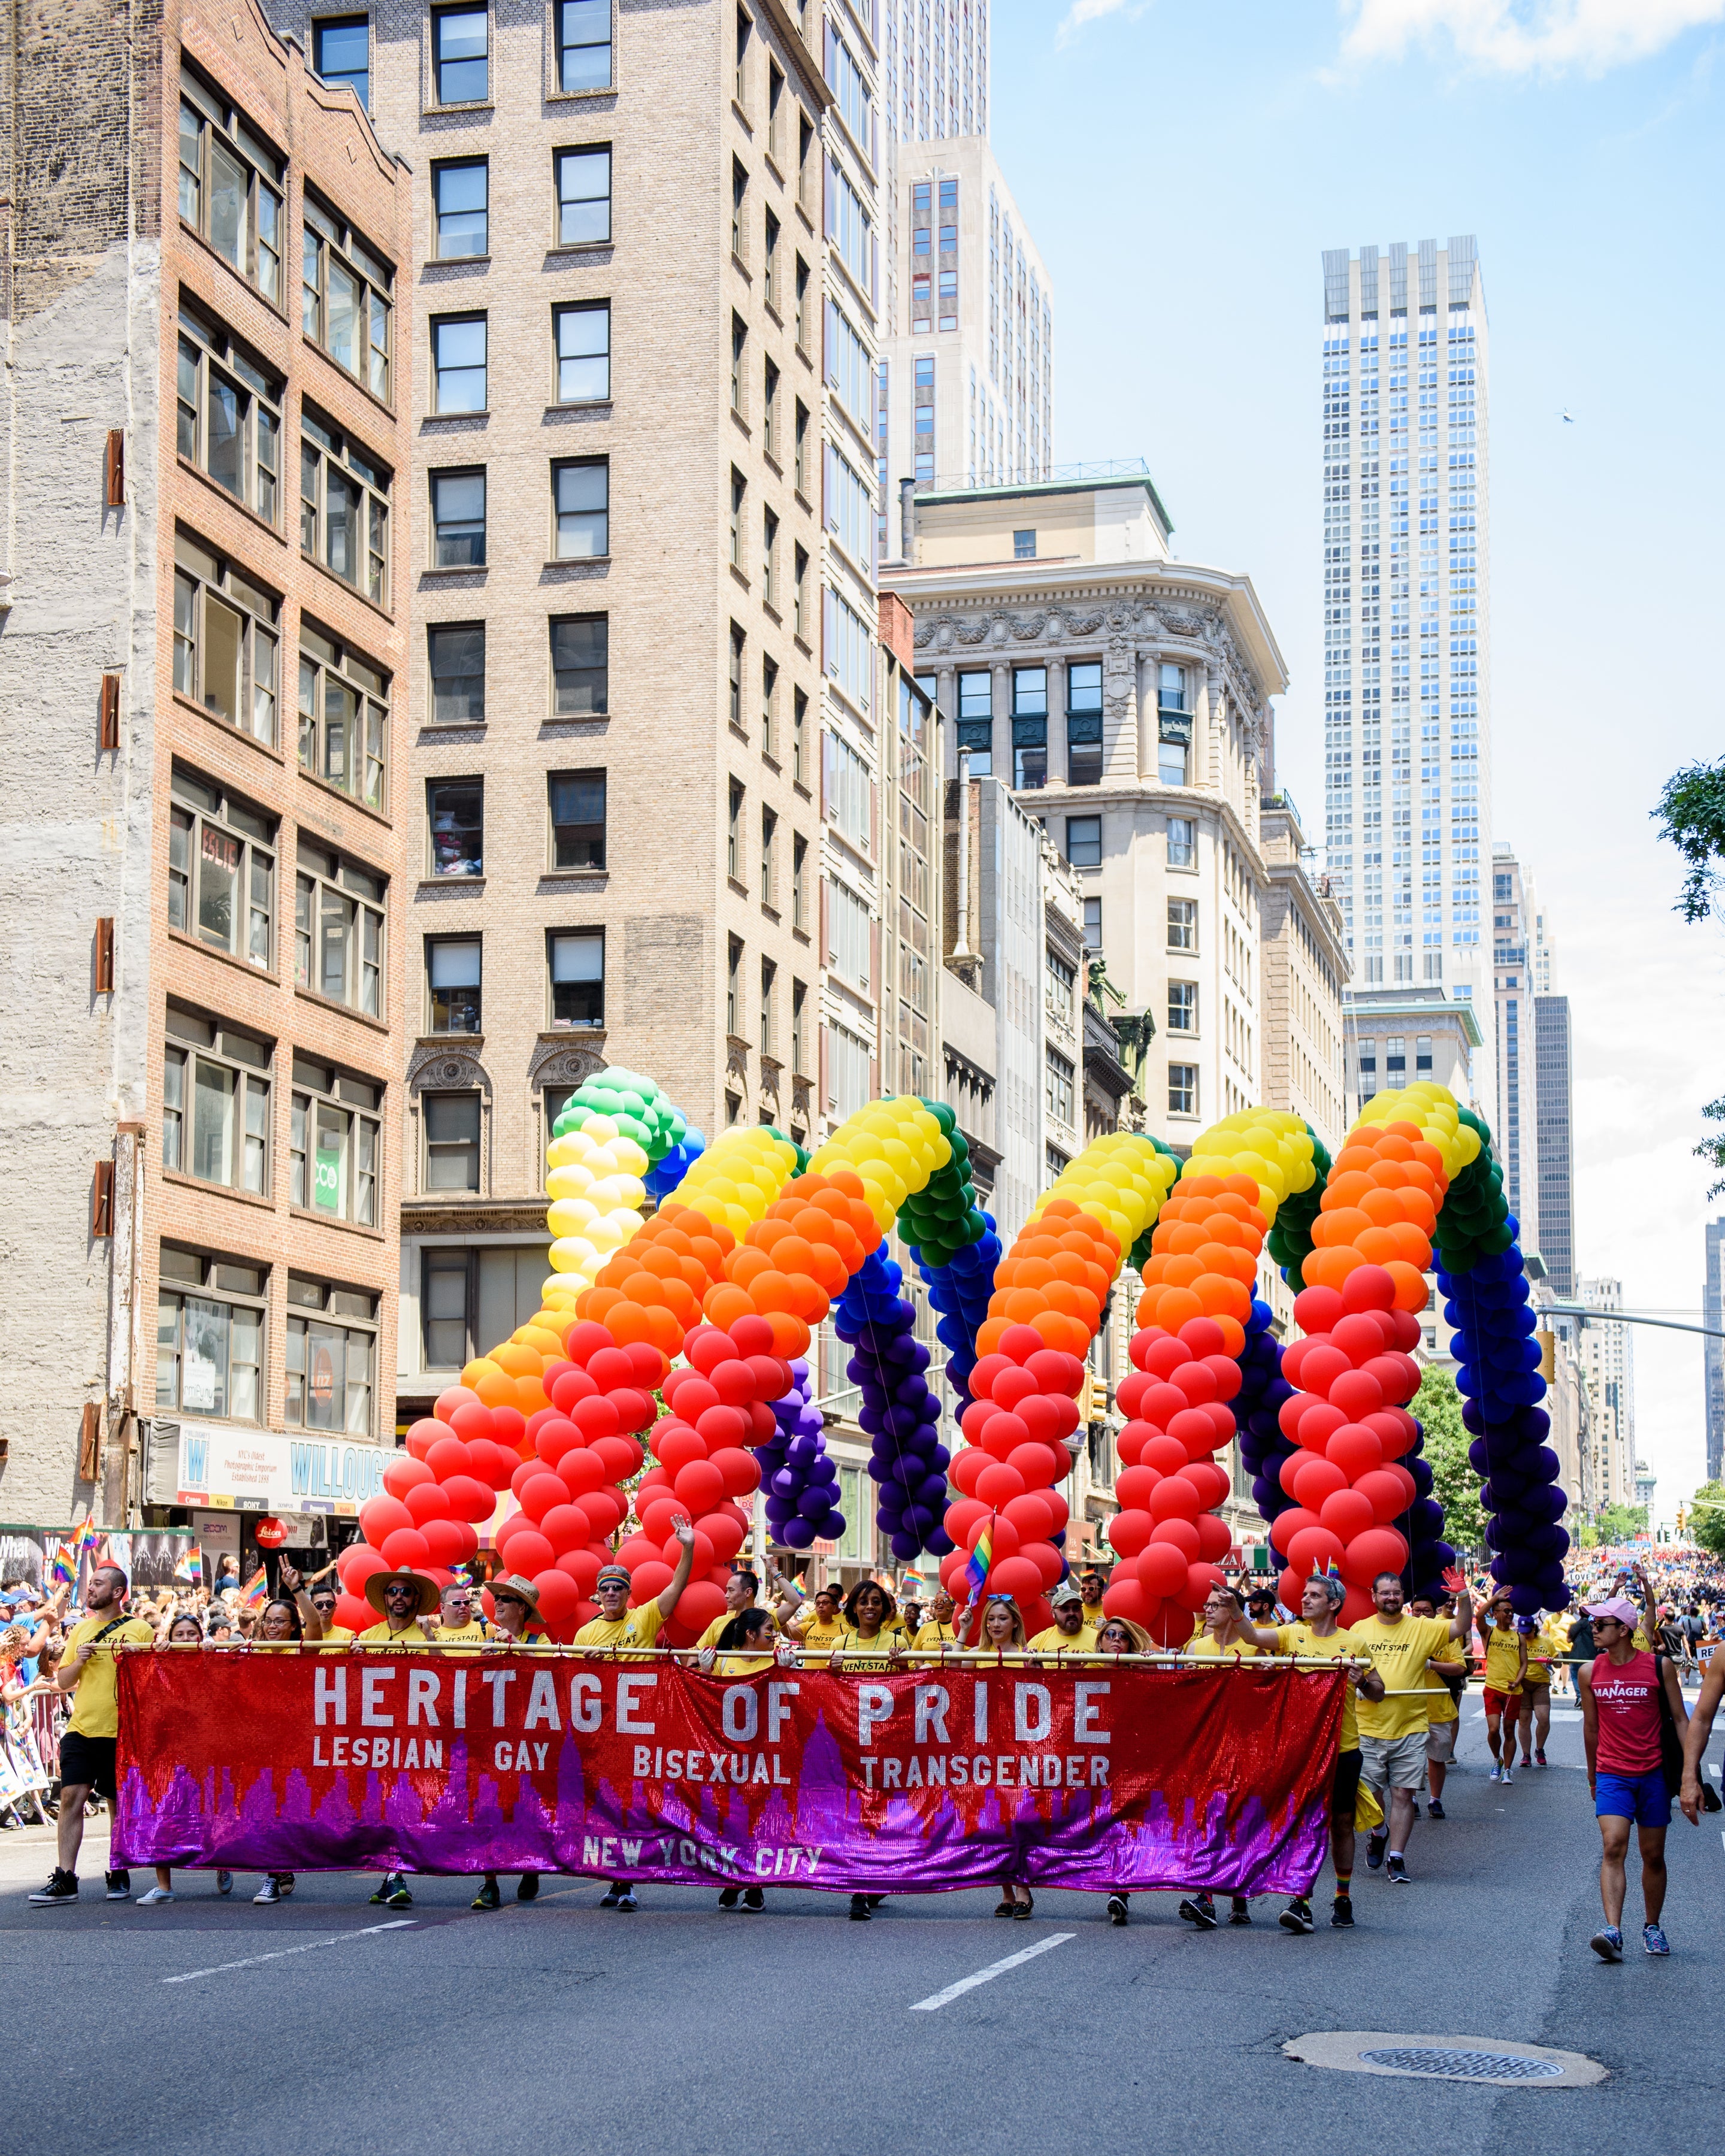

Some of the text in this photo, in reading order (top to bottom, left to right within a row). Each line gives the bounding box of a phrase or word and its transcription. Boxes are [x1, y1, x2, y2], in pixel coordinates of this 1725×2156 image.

[187, 1439, 207, 1482] W
[252, 1451, 265, 1461] Oldest
[225, 1459, 277, 1473] Photographic Emporium
[232, 1472, 269, 1483] Established 1898
[185, 1496, 201, 1505] Canon
[258, 1525, 282, 1538] Leica
[0, 1535, 29, 1558] What
[807, 1633, 824, 1642] EVENT
[1388, 1643, 1410, 1652] STAFF
[842, 1661, 894, 1672] EVENT STAFF
[1594, 1684, 1648, 1698] MANAGER
[314, 1667, 1110, 1745] HERITAGE OF PRIDE
[313, 1736, 1109, 1788] LESBIAN GAY BISEXUAL TRANSGENDER
[582, 1836, 823, 1876] NEW YORK CITY
